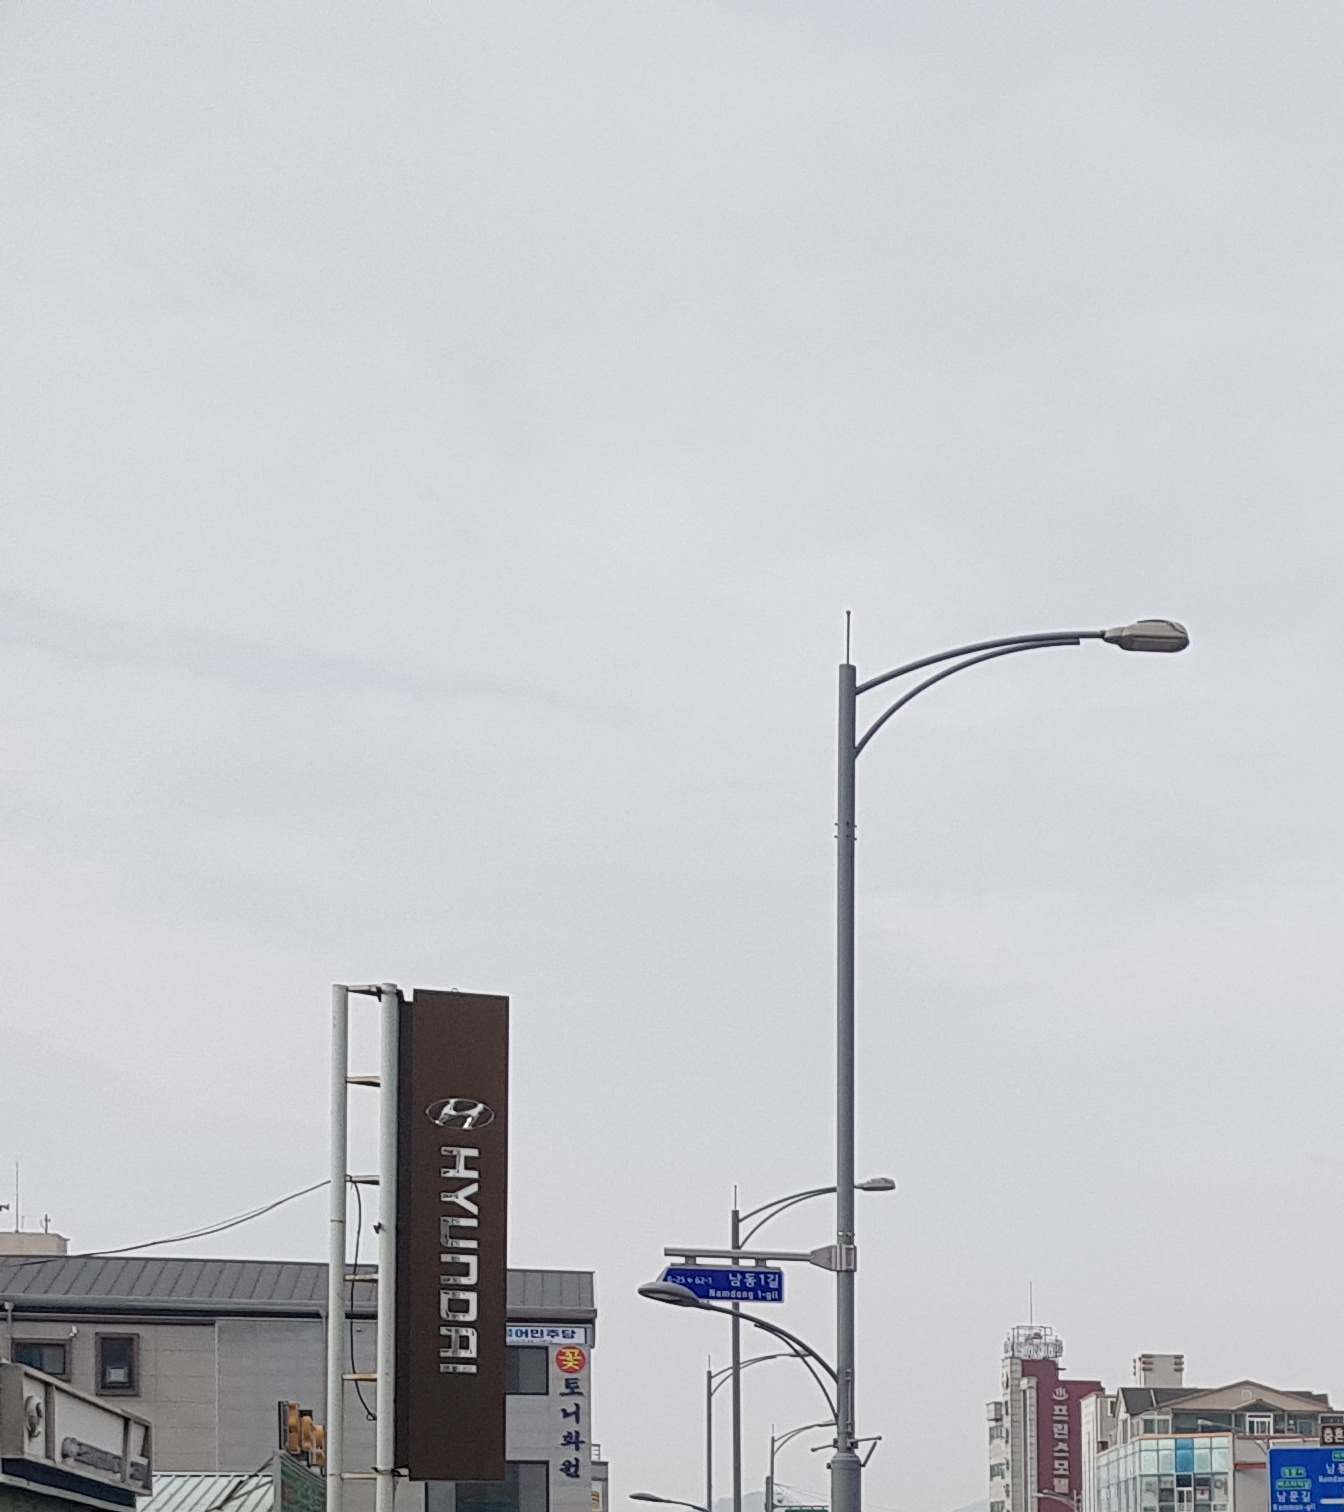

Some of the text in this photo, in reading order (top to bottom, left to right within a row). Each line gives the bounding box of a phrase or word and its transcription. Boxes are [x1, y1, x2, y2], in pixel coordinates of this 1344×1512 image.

[440, 1146, 479, 1374] HYUNDAI
[728, 1272, 779, 1289] 남동1길
[708, 1288, 754, 1299] Namdong
[557, 1348, 584, 1370] 꽃
[559, 1377, 586, 1479] 토니화원
